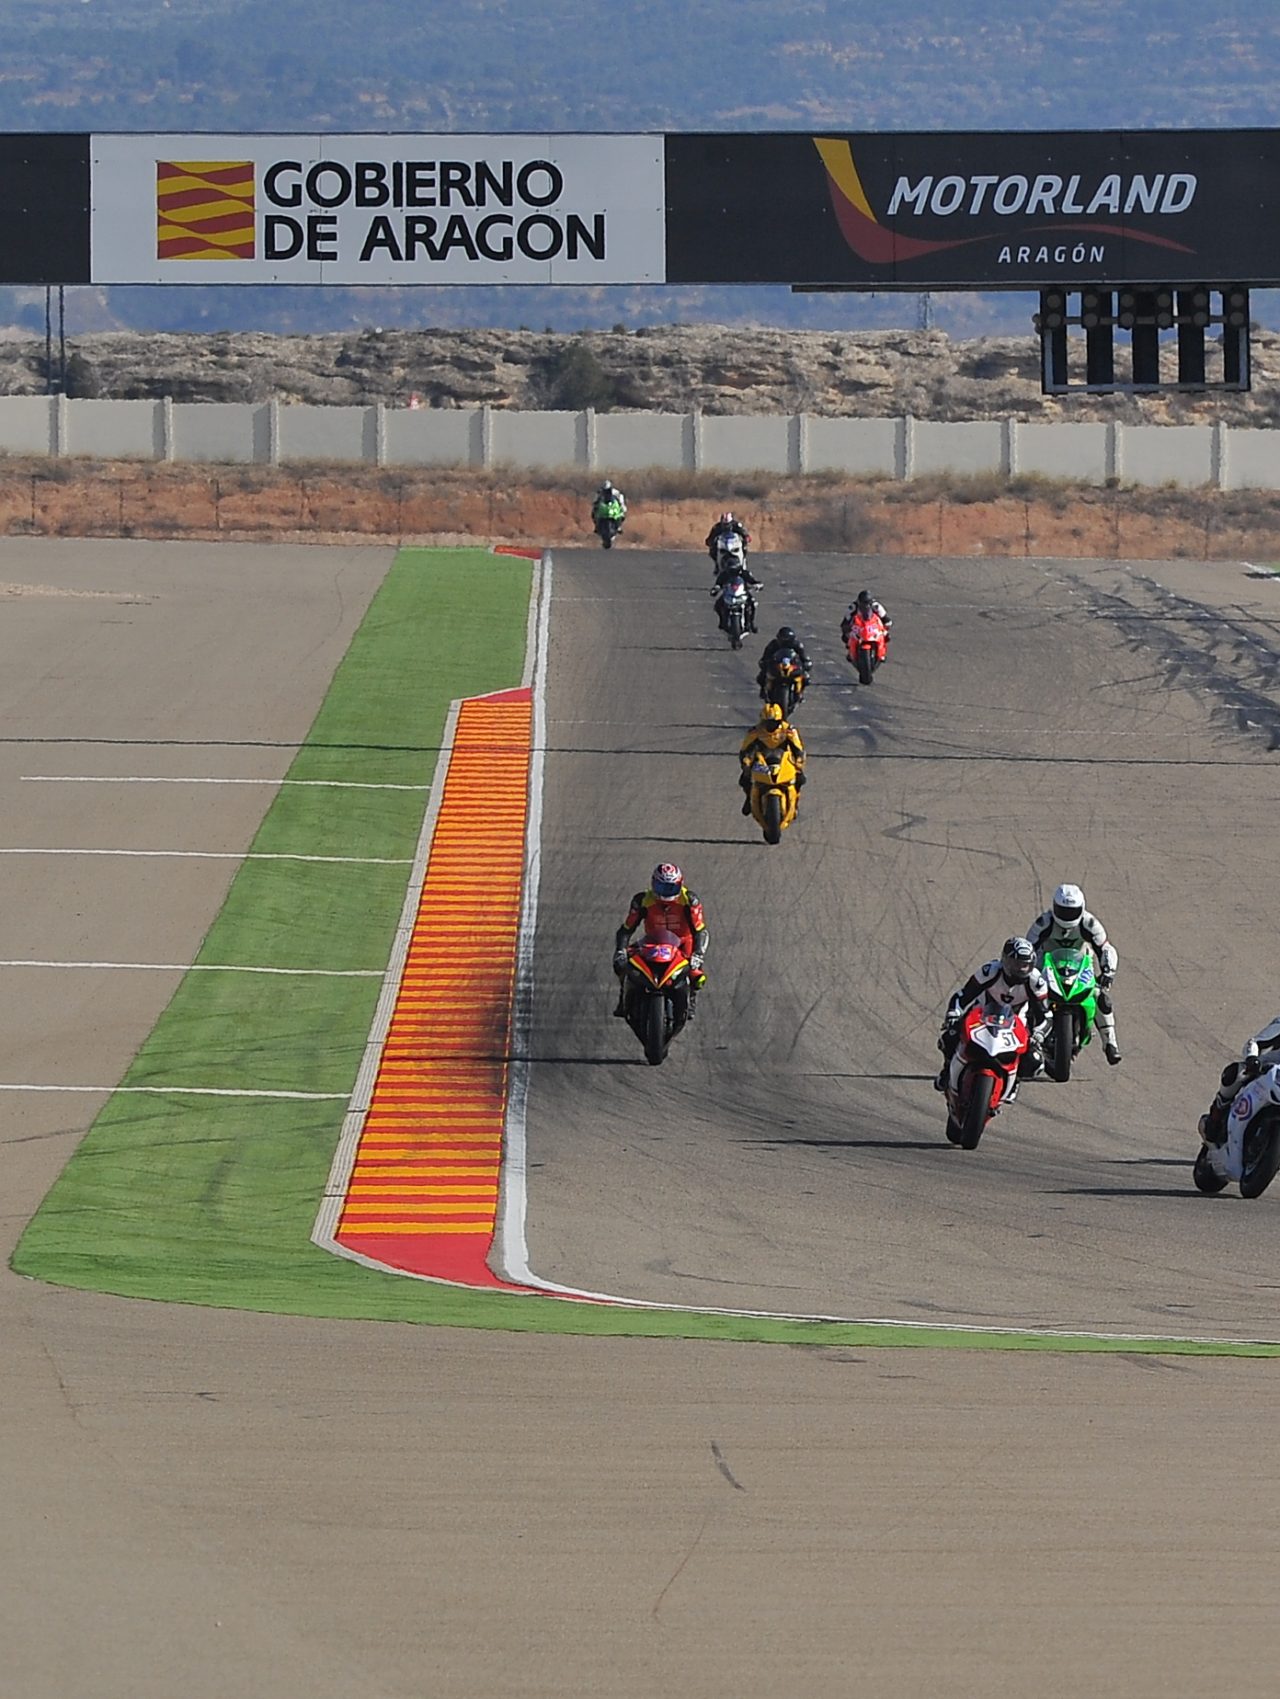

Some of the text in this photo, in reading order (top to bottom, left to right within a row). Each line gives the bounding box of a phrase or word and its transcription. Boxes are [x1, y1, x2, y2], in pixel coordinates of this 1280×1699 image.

[263, 160, 563, 209] GOBIERNO
[886, 173, 1198, 216] MOTORLAND
[264, 213, 606, 262] DE ARAGON
[997, 242, 1106, 264] ARAGÓN
[1002, 1032, 1017, 1046] 57
